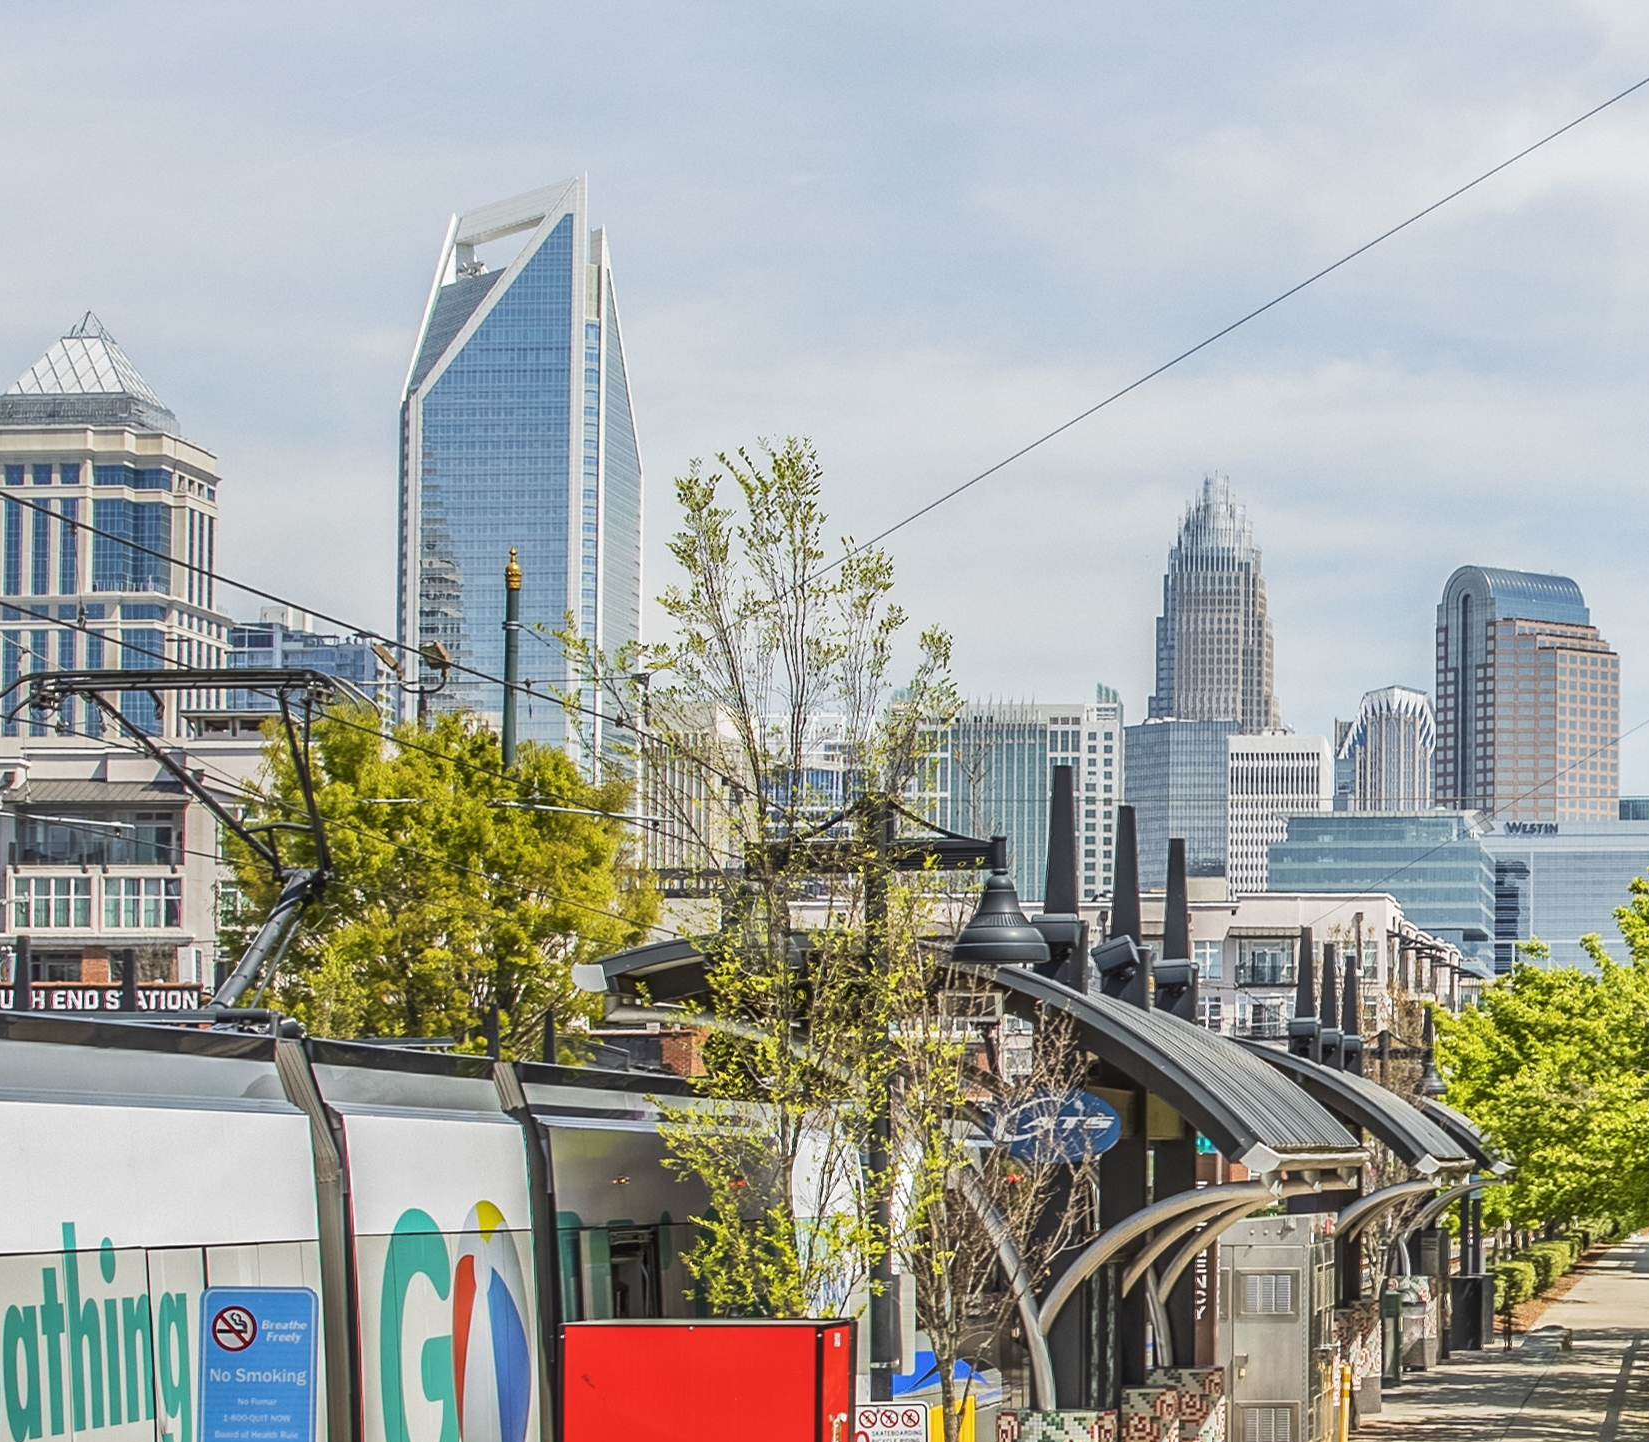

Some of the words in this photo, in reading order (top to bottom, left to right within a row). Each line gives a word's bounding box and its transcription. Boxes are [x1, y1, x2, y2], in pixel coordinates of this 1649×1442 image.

[1505, 821, 1559, 834] WESTIN
[51, 989, 99, 1010] END
[103, 989, 199, 1010] SATION
[261, 1319, 308, 1331] Breathe
[266, 1331, 302, 1344] Freely
[209, 1368, 231, 1383] No
[235, 1368, 308, 1386] Smoking
[237, 1397, 249, 1406] No
[250, 1397, 277, 1406] Fumar
[223, 1413, 268, 1422] 1-800-QUIT
[270, 1413, 292, 1422] NOW
[214, 1430, 239, 1439] Board
[240, 1430, 250, 1439] of
[250, 1430, 278, 1439] Health
[279, 1430, 299, 1439] Rule
